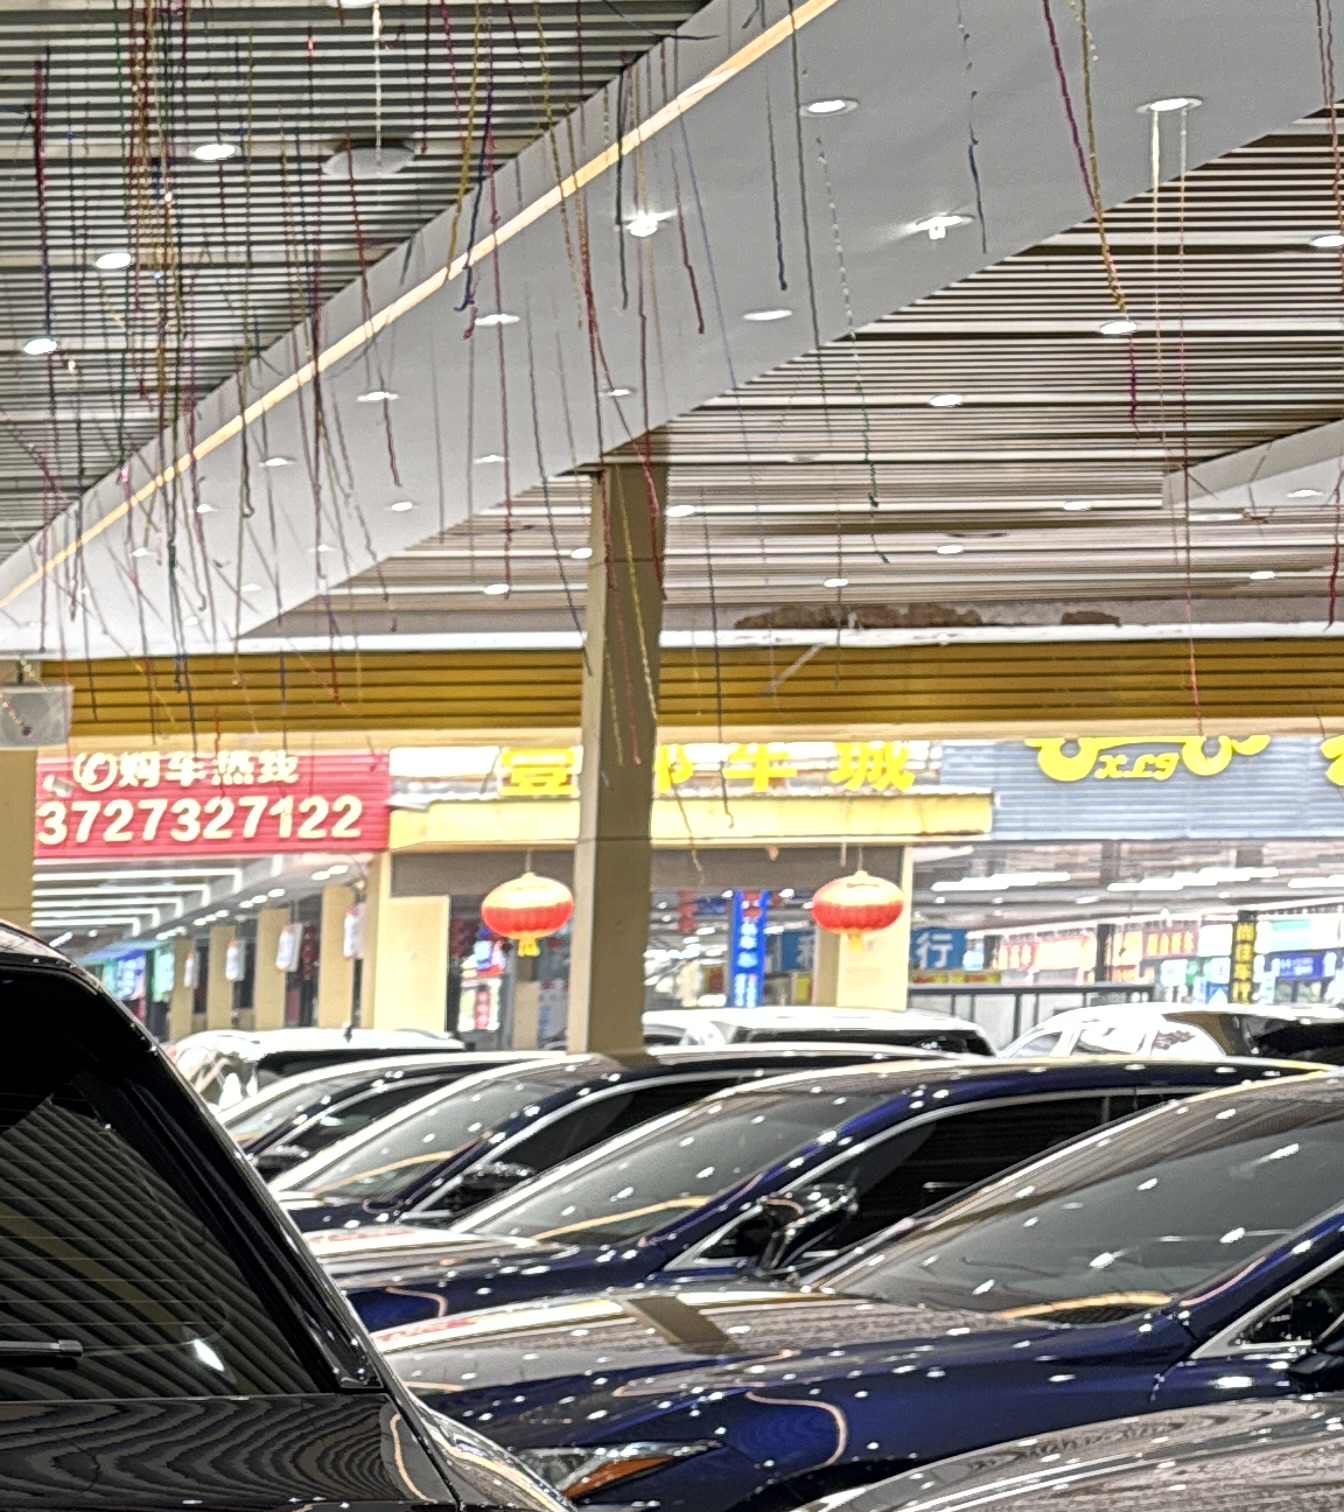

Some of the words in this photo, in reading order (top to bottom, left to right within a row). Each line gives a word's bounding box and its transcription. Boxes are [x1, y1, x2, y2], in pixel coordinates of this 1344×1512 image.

[118, 750, 299, 787] 购车热线
[36, 796, 363, 845] 3727327122
